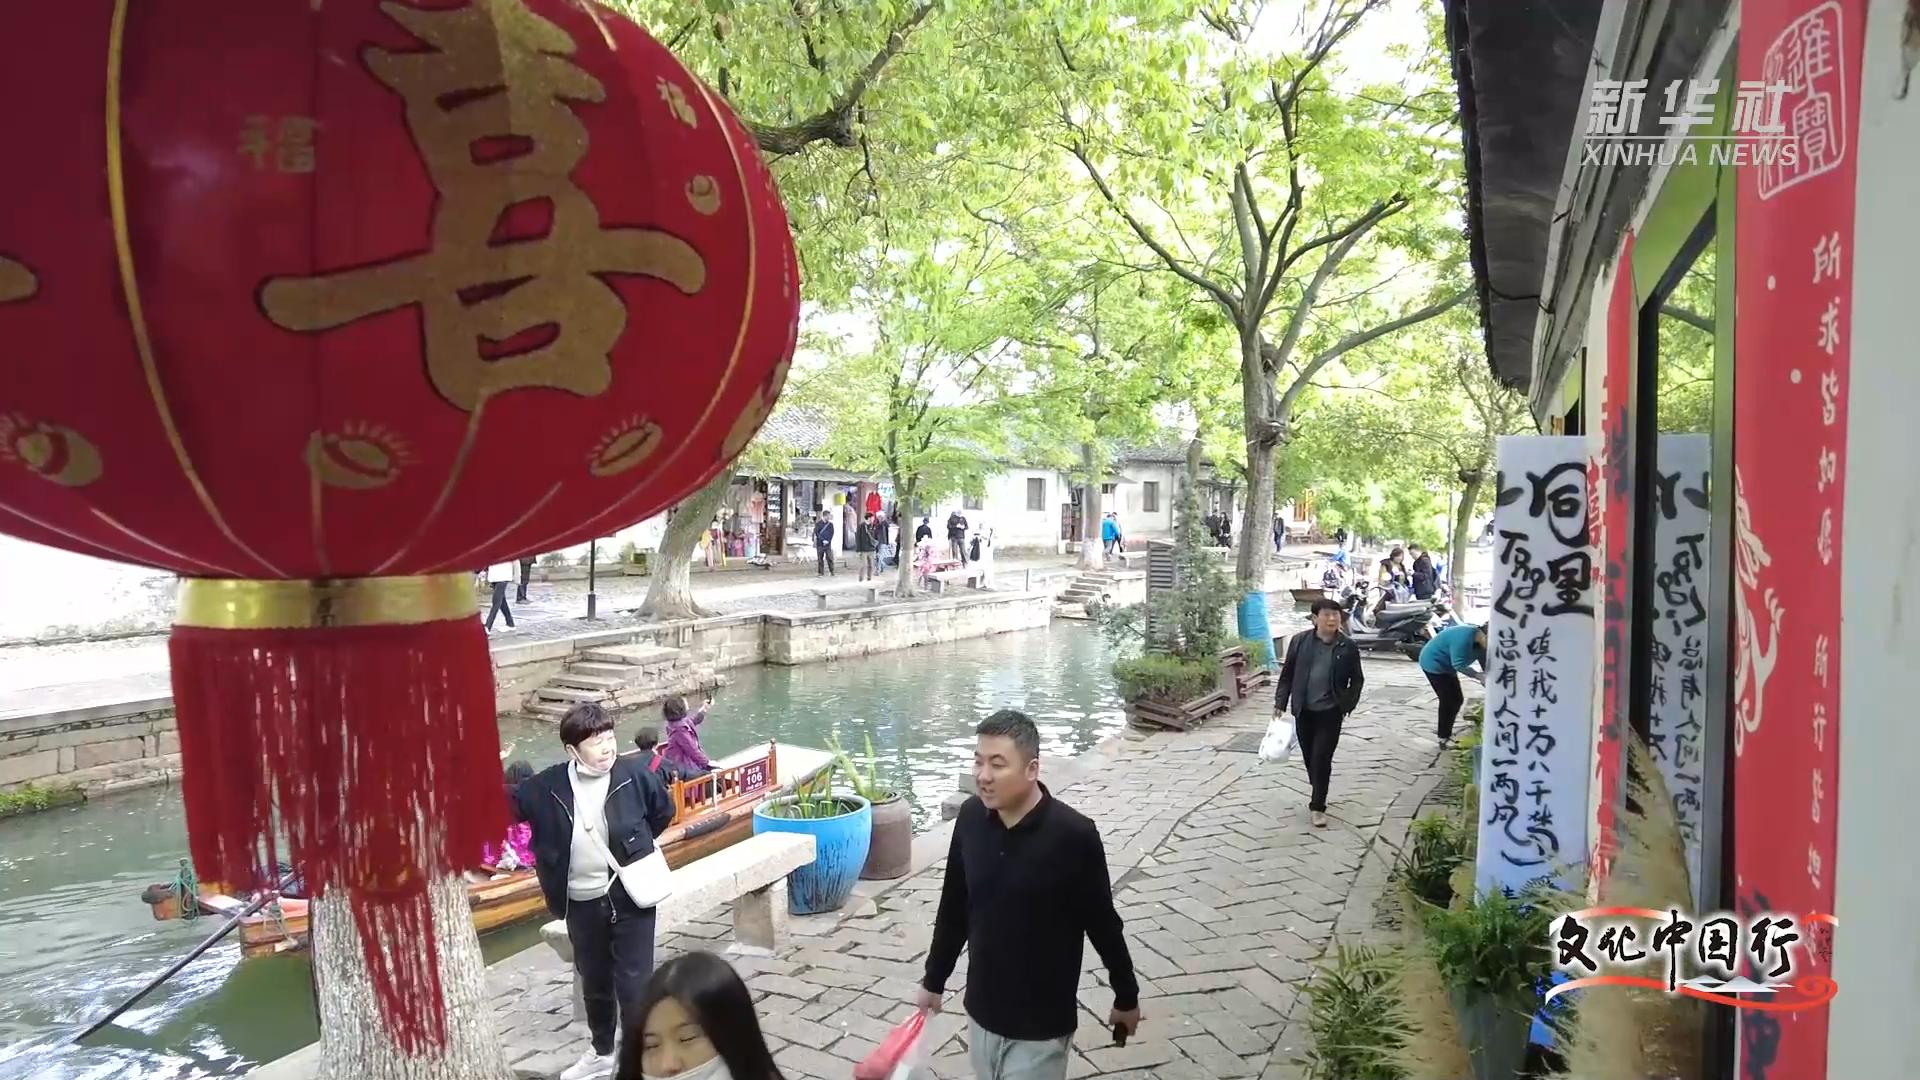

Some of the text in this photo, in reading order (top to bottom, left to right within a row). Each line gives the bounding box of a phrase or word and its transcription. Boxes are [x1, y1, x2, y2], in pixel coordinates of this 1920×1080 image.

[746, 771, 763, 786] 106
[1487, 627, 1532, 846] 总有人间一两风
